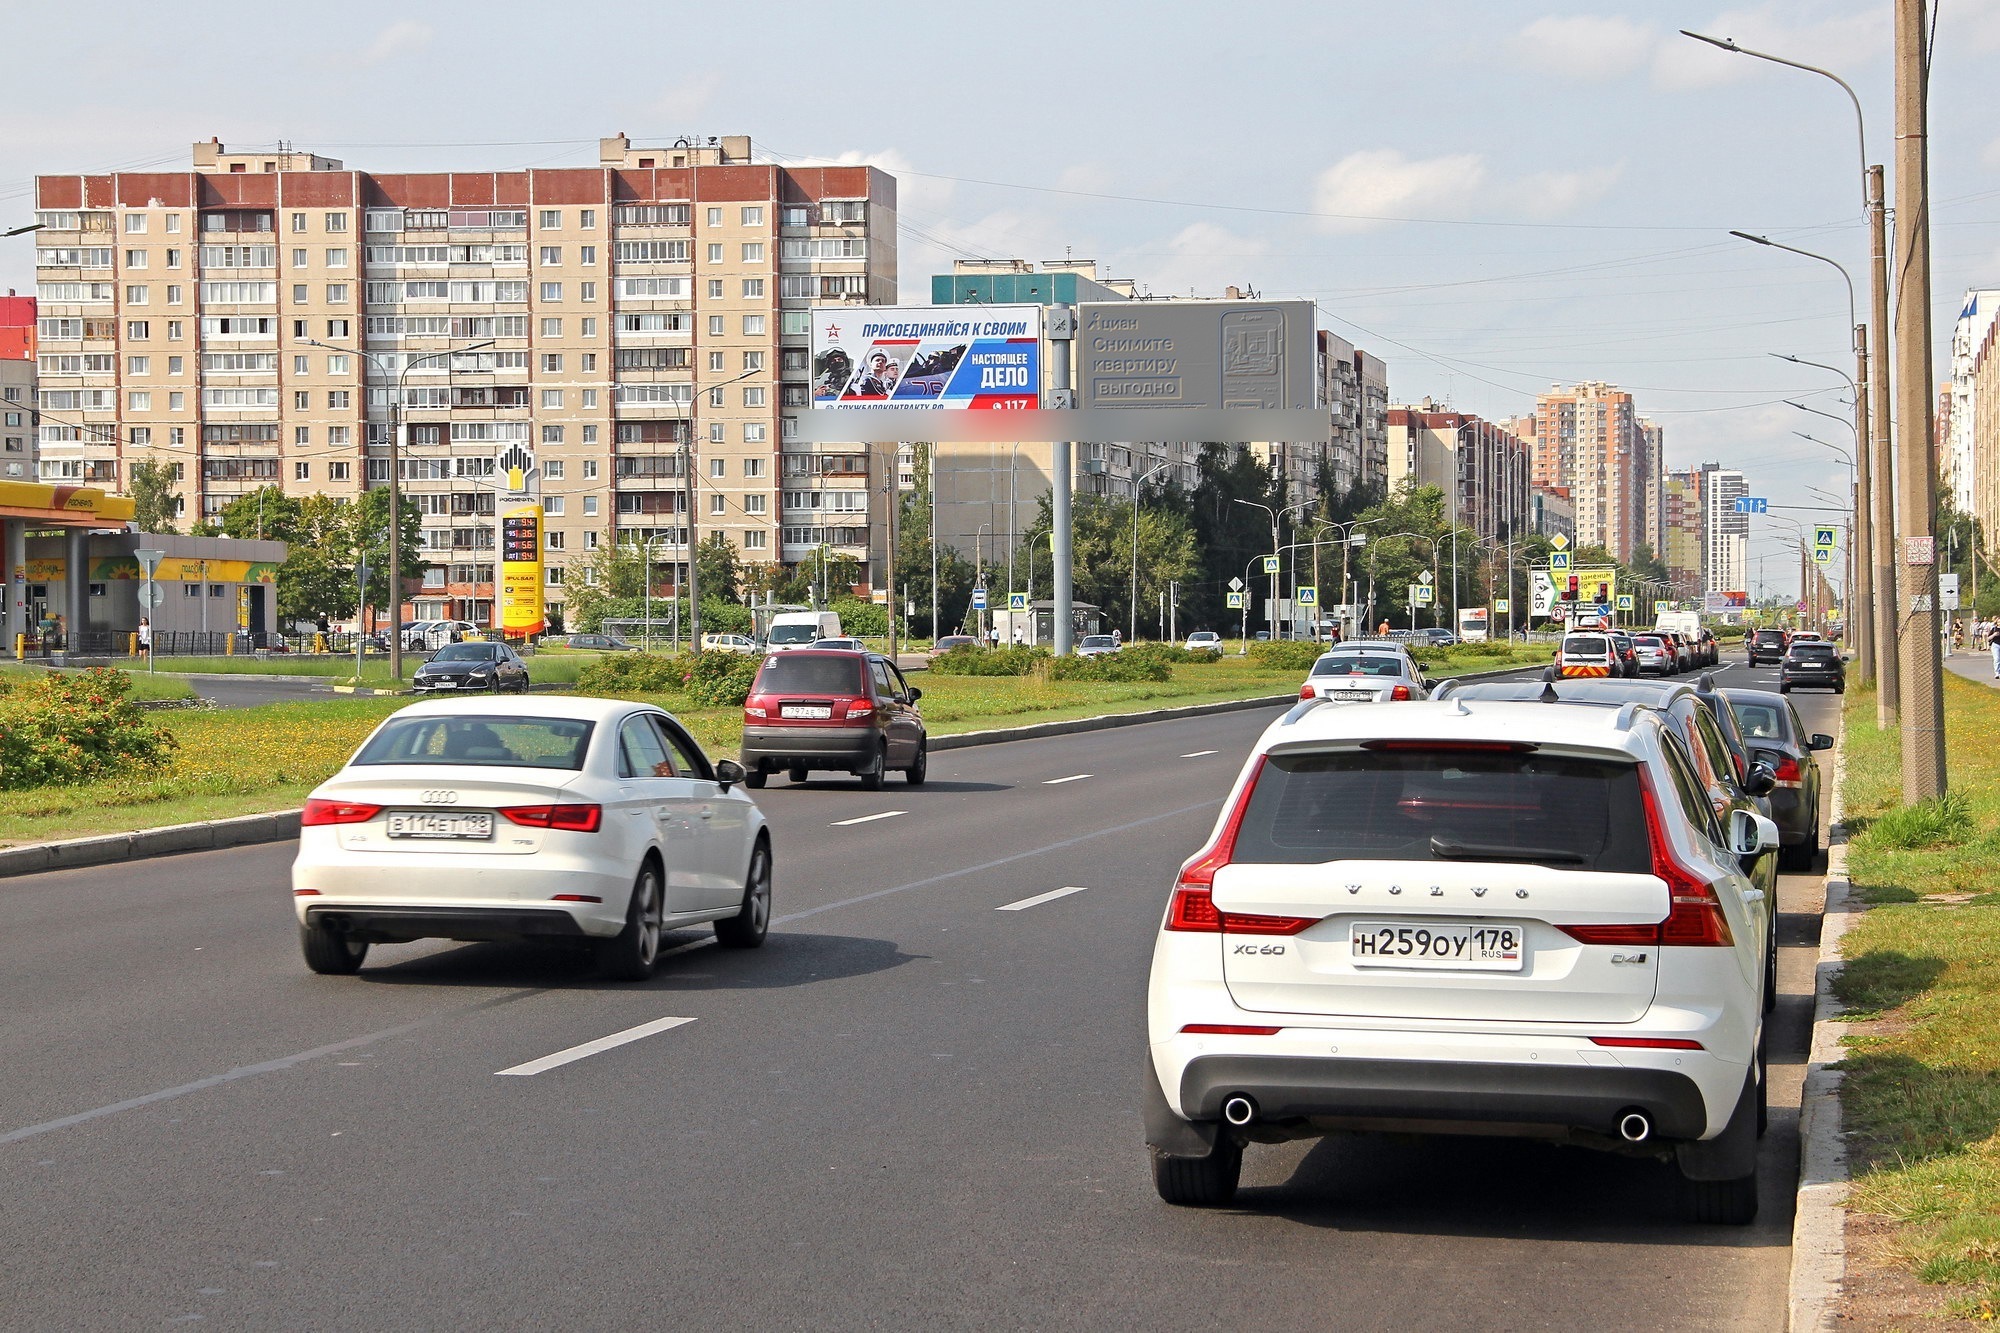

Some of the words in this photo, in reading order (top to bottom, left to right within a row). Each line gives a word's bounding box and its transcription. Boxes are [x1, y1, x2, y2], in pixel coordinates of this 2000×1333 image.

[862, 320, 970, 338] ПРИСОЕДИНЯЙСЯ
[972, 323, 981, 336] К
[983, 322, 1027, 336] СВОИМ
[1101, 319, 1139, 331] циан
[1093, 337, 1174, 352] Снимите
[971, 353, 1028, 365] НАСТОЯЩЕЕ
[1093, 359, 1177, 375] квартиру
[980, 367, 1028, 389] ДЕЛО
[1099, 382, 1176, 397] выгодно
[394, 815, 458, 832] В114ЕТ
[462, 815, 488, 828] 198
[1345, 885, 1530, 899] VOLVO
[1361, 928, 1467, 956] Н259ОУ
[1474, 929, 1513, 950] 178
[1481, 950, 1501, 958] RUS
